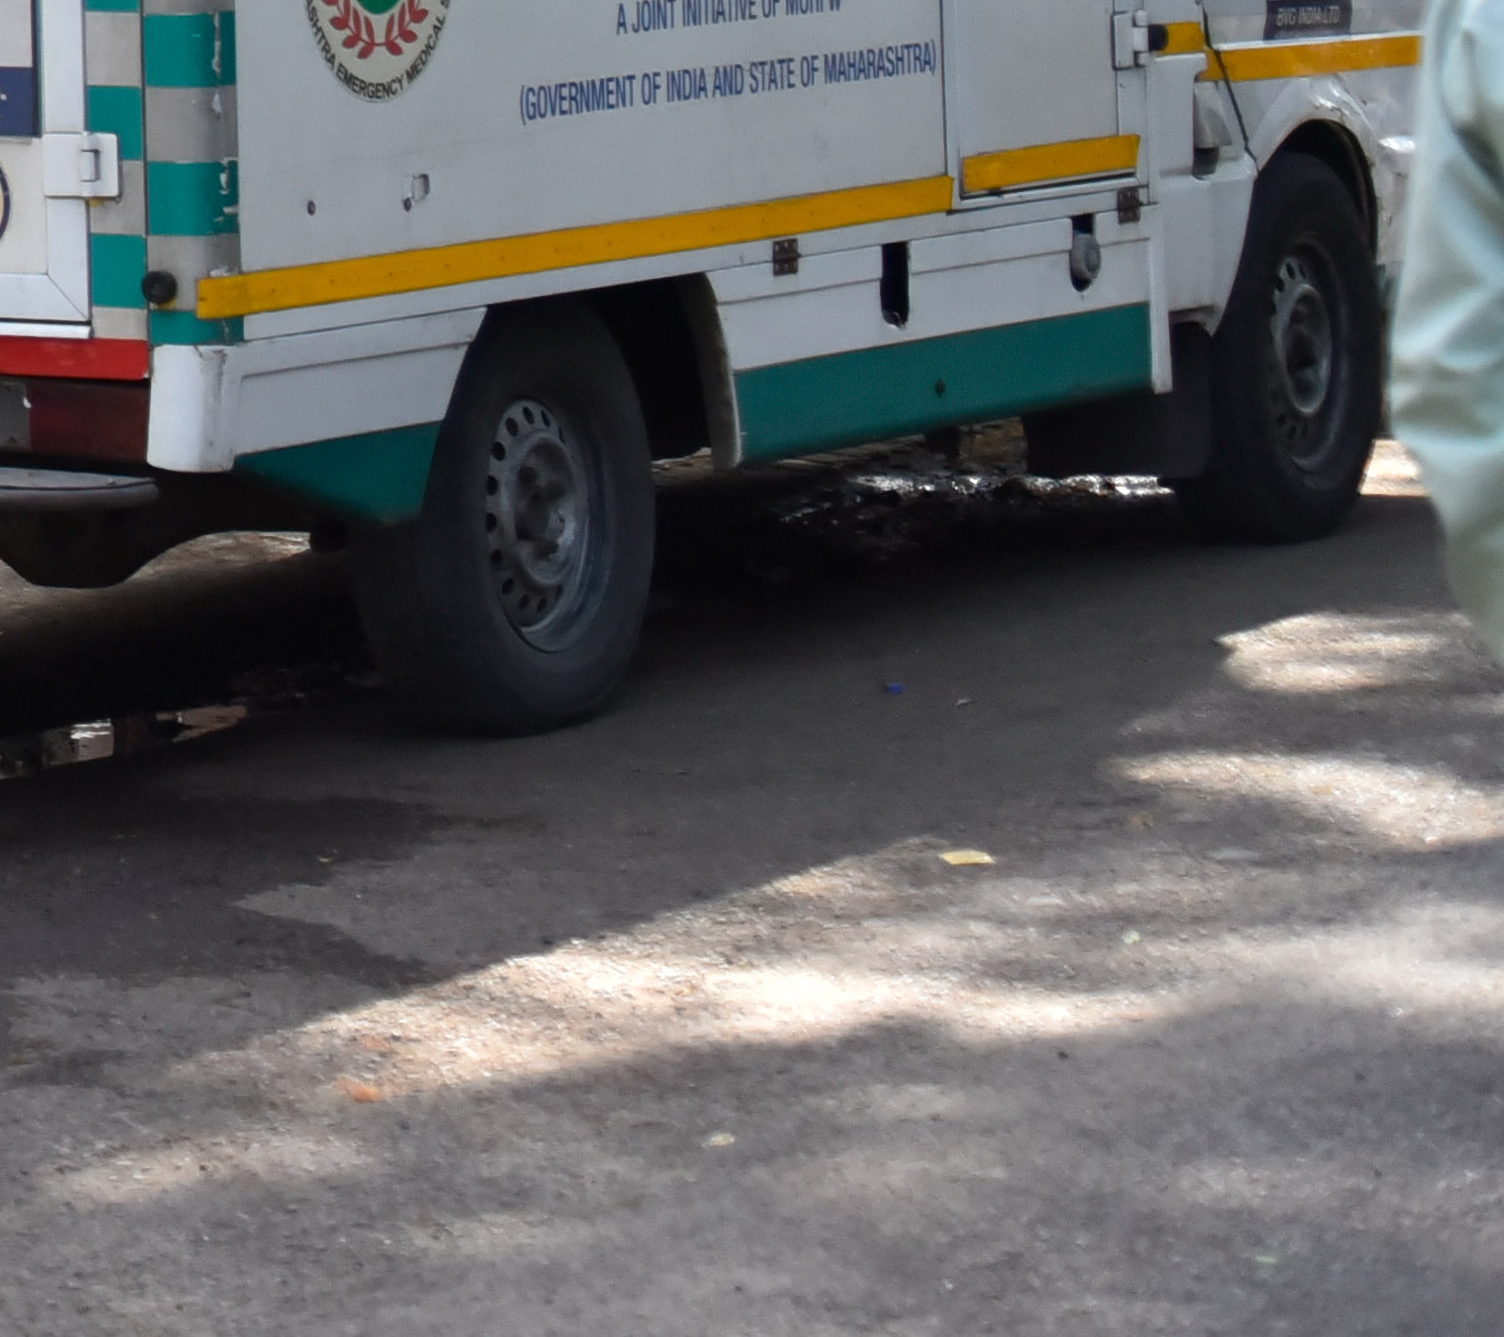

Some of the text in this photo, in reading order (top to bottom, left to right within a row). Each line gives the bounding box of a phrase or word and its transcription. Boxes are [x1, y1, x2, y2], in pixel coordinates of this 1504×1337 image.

[335, 61, 406, 100] EMERGENCY
[404, 14, 447, 84] MEDICAL
[616, 2, 628, 36] A
[519, 38, 938, 126] (GOVERNMENT OF INDIA AND STATE OF MAHARASHTRA)
